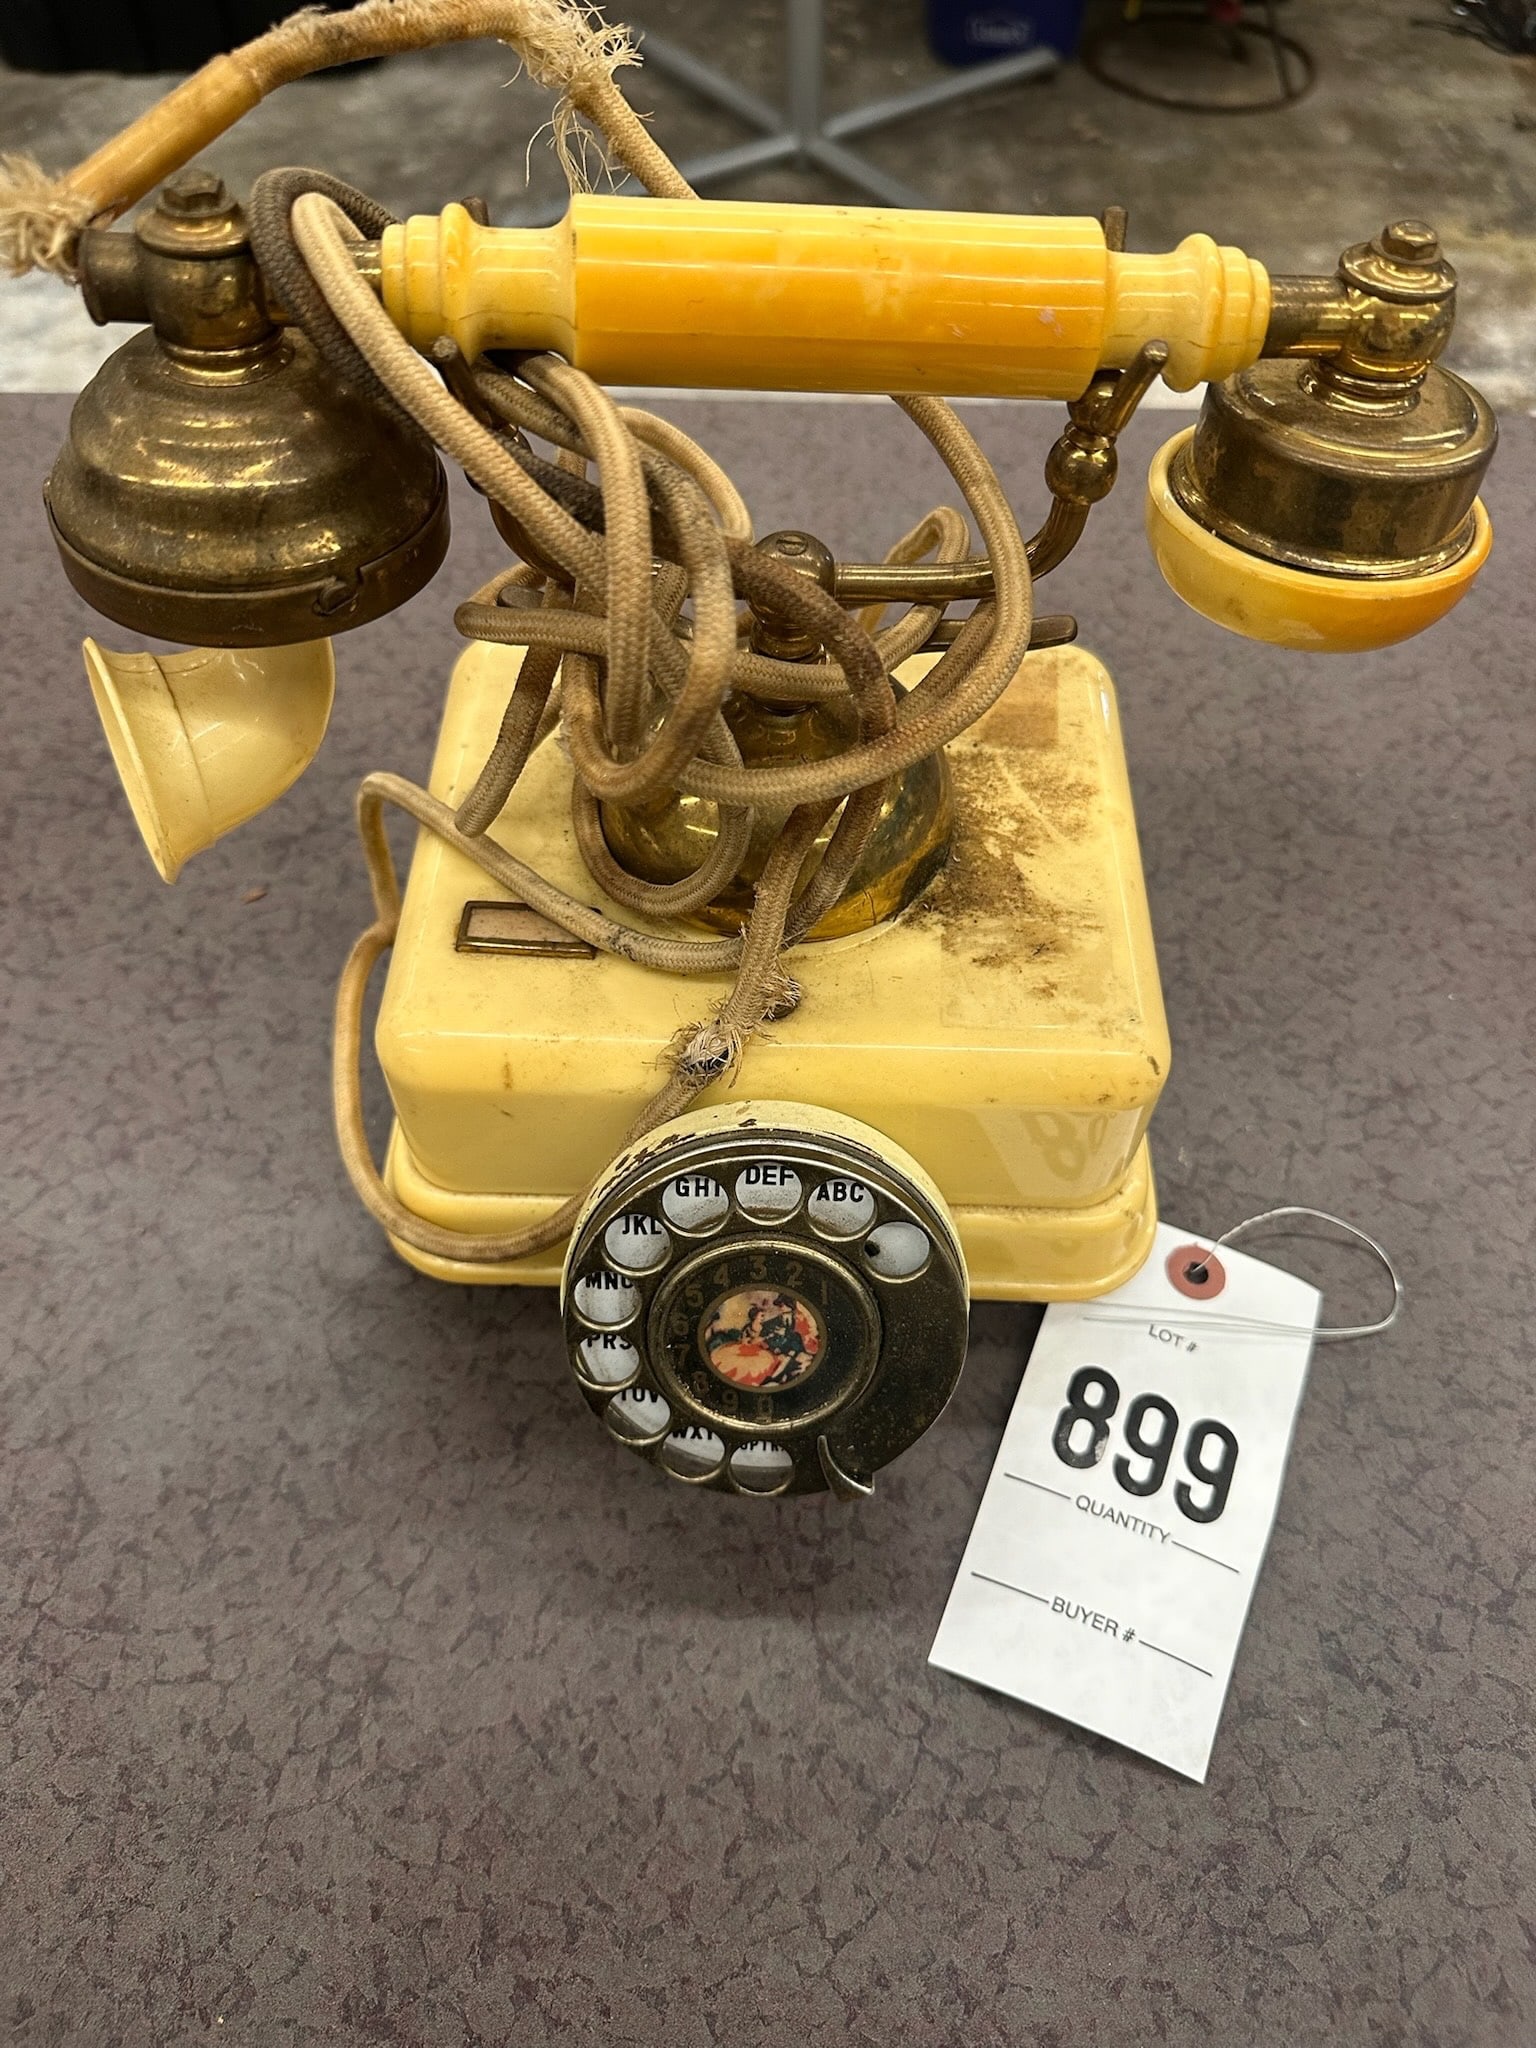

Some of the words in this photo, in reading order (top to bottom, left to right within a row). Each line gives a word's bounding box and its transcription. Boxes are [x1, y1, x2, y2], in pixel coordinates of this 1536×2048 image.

[675, 1177, 720, 1198] GHI
[745, 1165, 795, 1186] DEF
[816, 1181, 865, 1203] ABC
[621, 1215, 663, 1236] JKL
[785, 1261, 803, 1287] 2
[1148, 1323, 1185, 1348] LOT
[1053, 1365, 1239, 1524] 899
[1076, 1494, 1171, 1544] QUANTITY
[1051, 1595, 1119, 1637] BUYER
